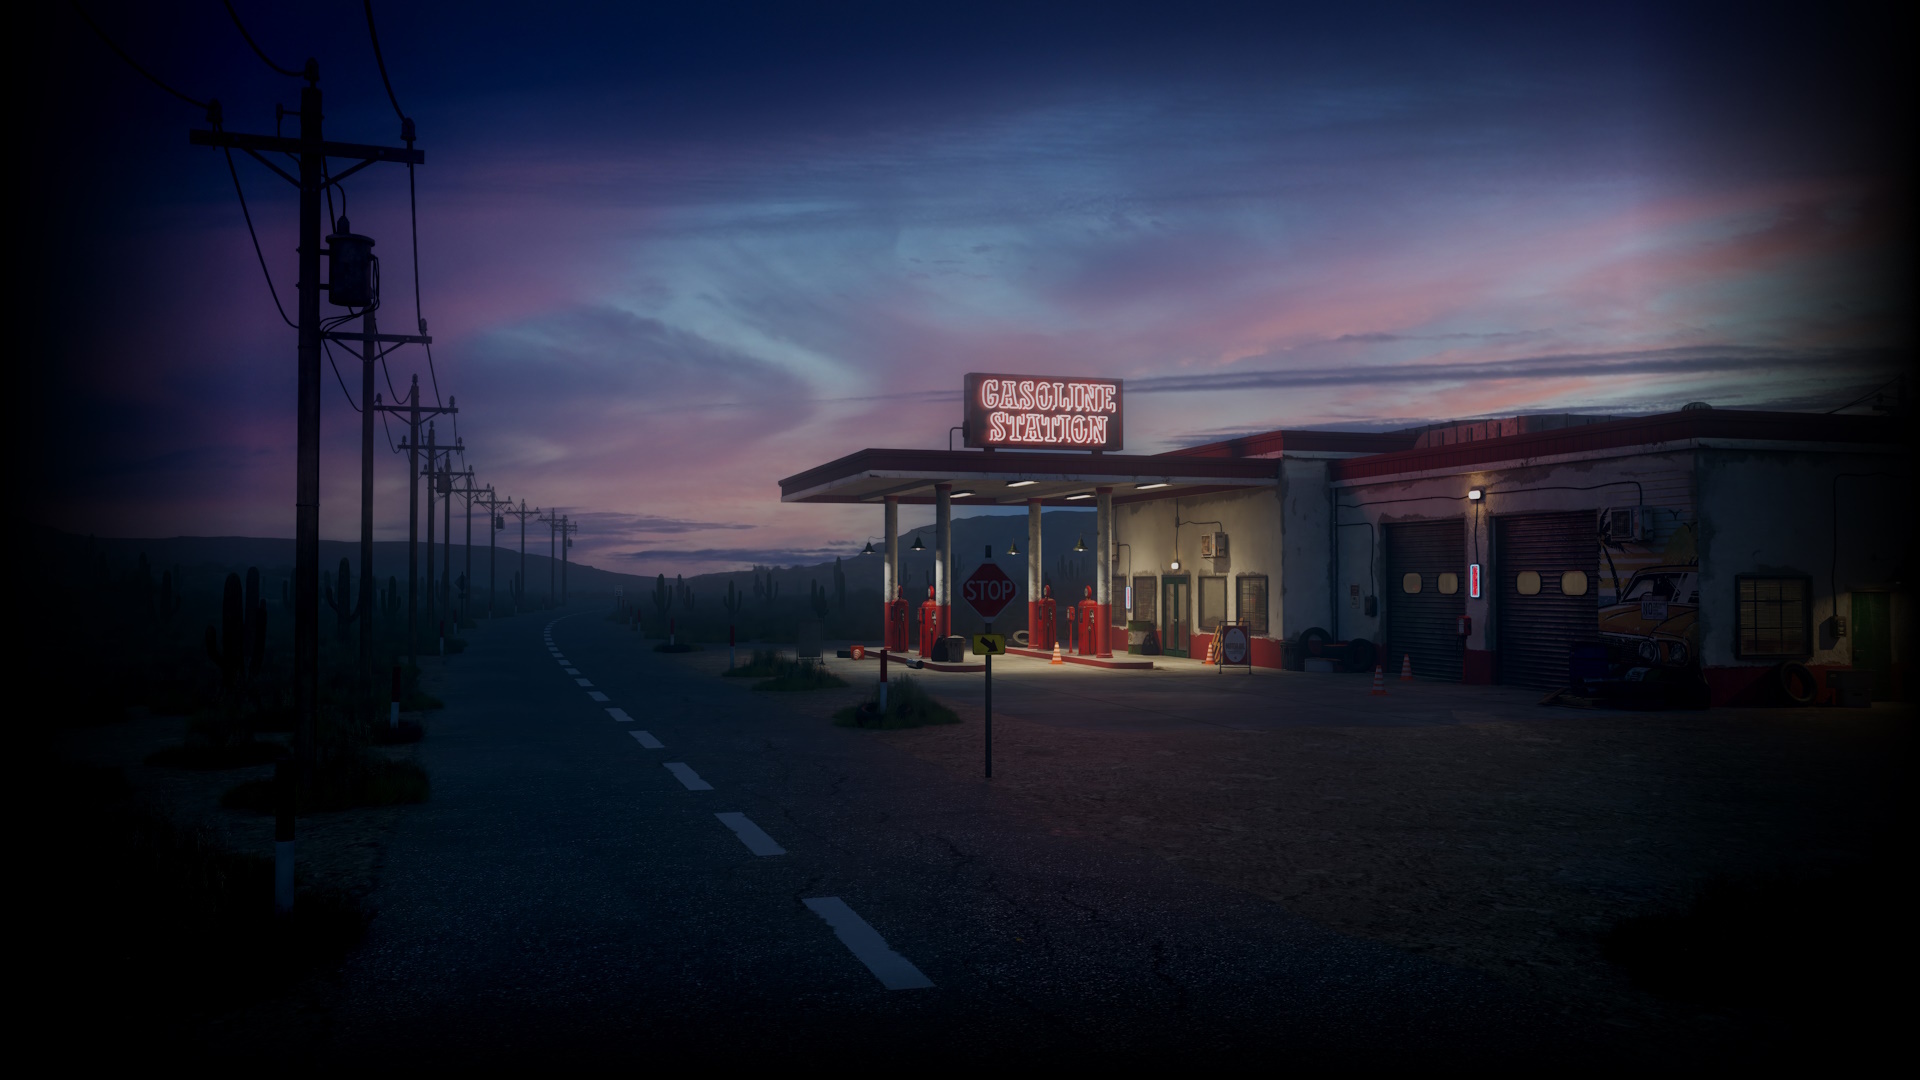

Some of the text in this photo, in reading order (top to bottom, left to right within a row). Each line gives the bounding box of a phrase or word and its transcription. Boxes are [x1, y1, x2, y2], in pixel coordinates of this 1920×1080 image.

[981, 379, 1117, 413] GASOLINE
[989, 411, 1108, 444] STATION
[965, 579, 1013, 601] STOP
[1642, 602, 1653, 615] NO
